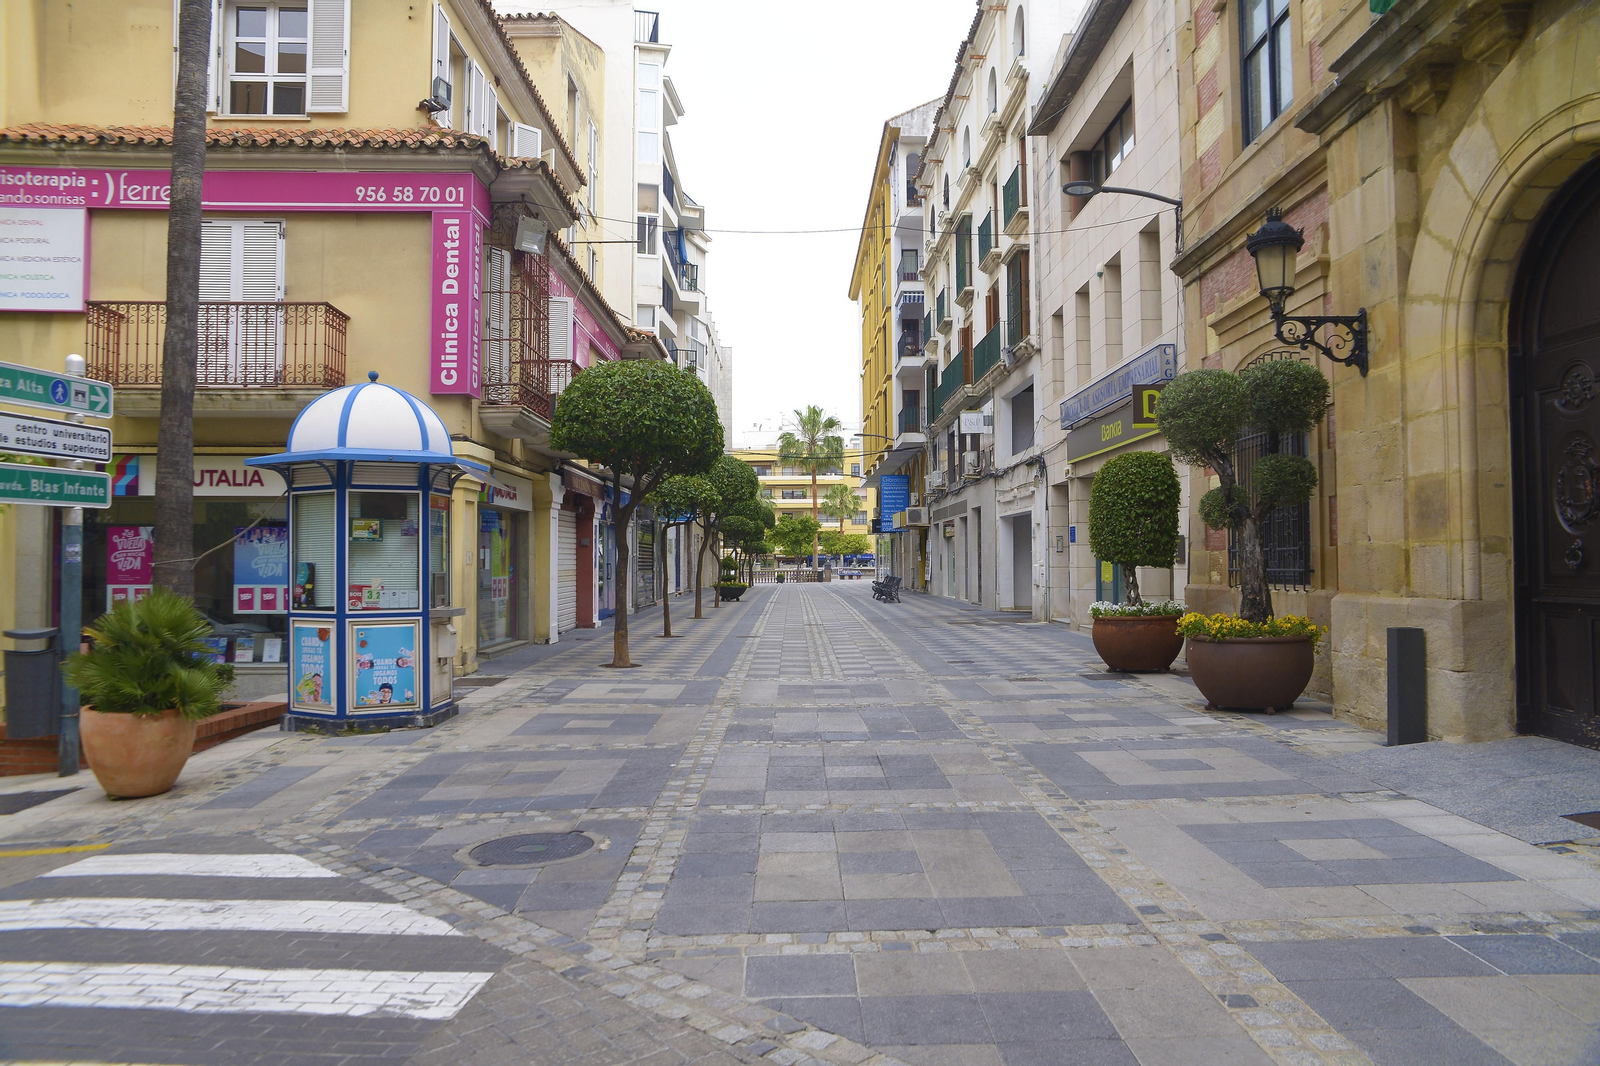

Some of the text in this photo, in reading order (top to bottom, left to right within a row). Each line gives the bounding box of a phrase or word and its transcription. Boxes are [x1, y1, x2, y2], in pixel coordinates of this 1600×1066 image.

[35, 192, 85, 205] sonrisas
[355, 186, 464, 202] 956 58 70 01
[440, 218, 460, 386] Clinica Dental
[472, 222, 480, 389] Clinica Dental
[1163, 346, 1171, 356] C
[1117, 355, 1160, 394] EMPRESARIAL
[1164, 368, 1173, 378] G
[16, 378, 44, 394] Alta
[15, 423, 108, 444] centro universitario
[1101, 420, 1122, 442] Bankia
[15, 435, 57, 449] estudios
[62, 442, 107, 456] superiores
[31, 478, 59, 493] Blas
[64, 480, 105, 496] Infante
[301, 636, 324, 648] CUANDO
[301, 654, 324, 664] JUGAMOS
[374, 658, 397, 666] CUANDO
[301, 663, 324, 677] TODOS
[373, 669, 398, 677] JUGAMOS
[373, 676, 398, 685] TODOS
